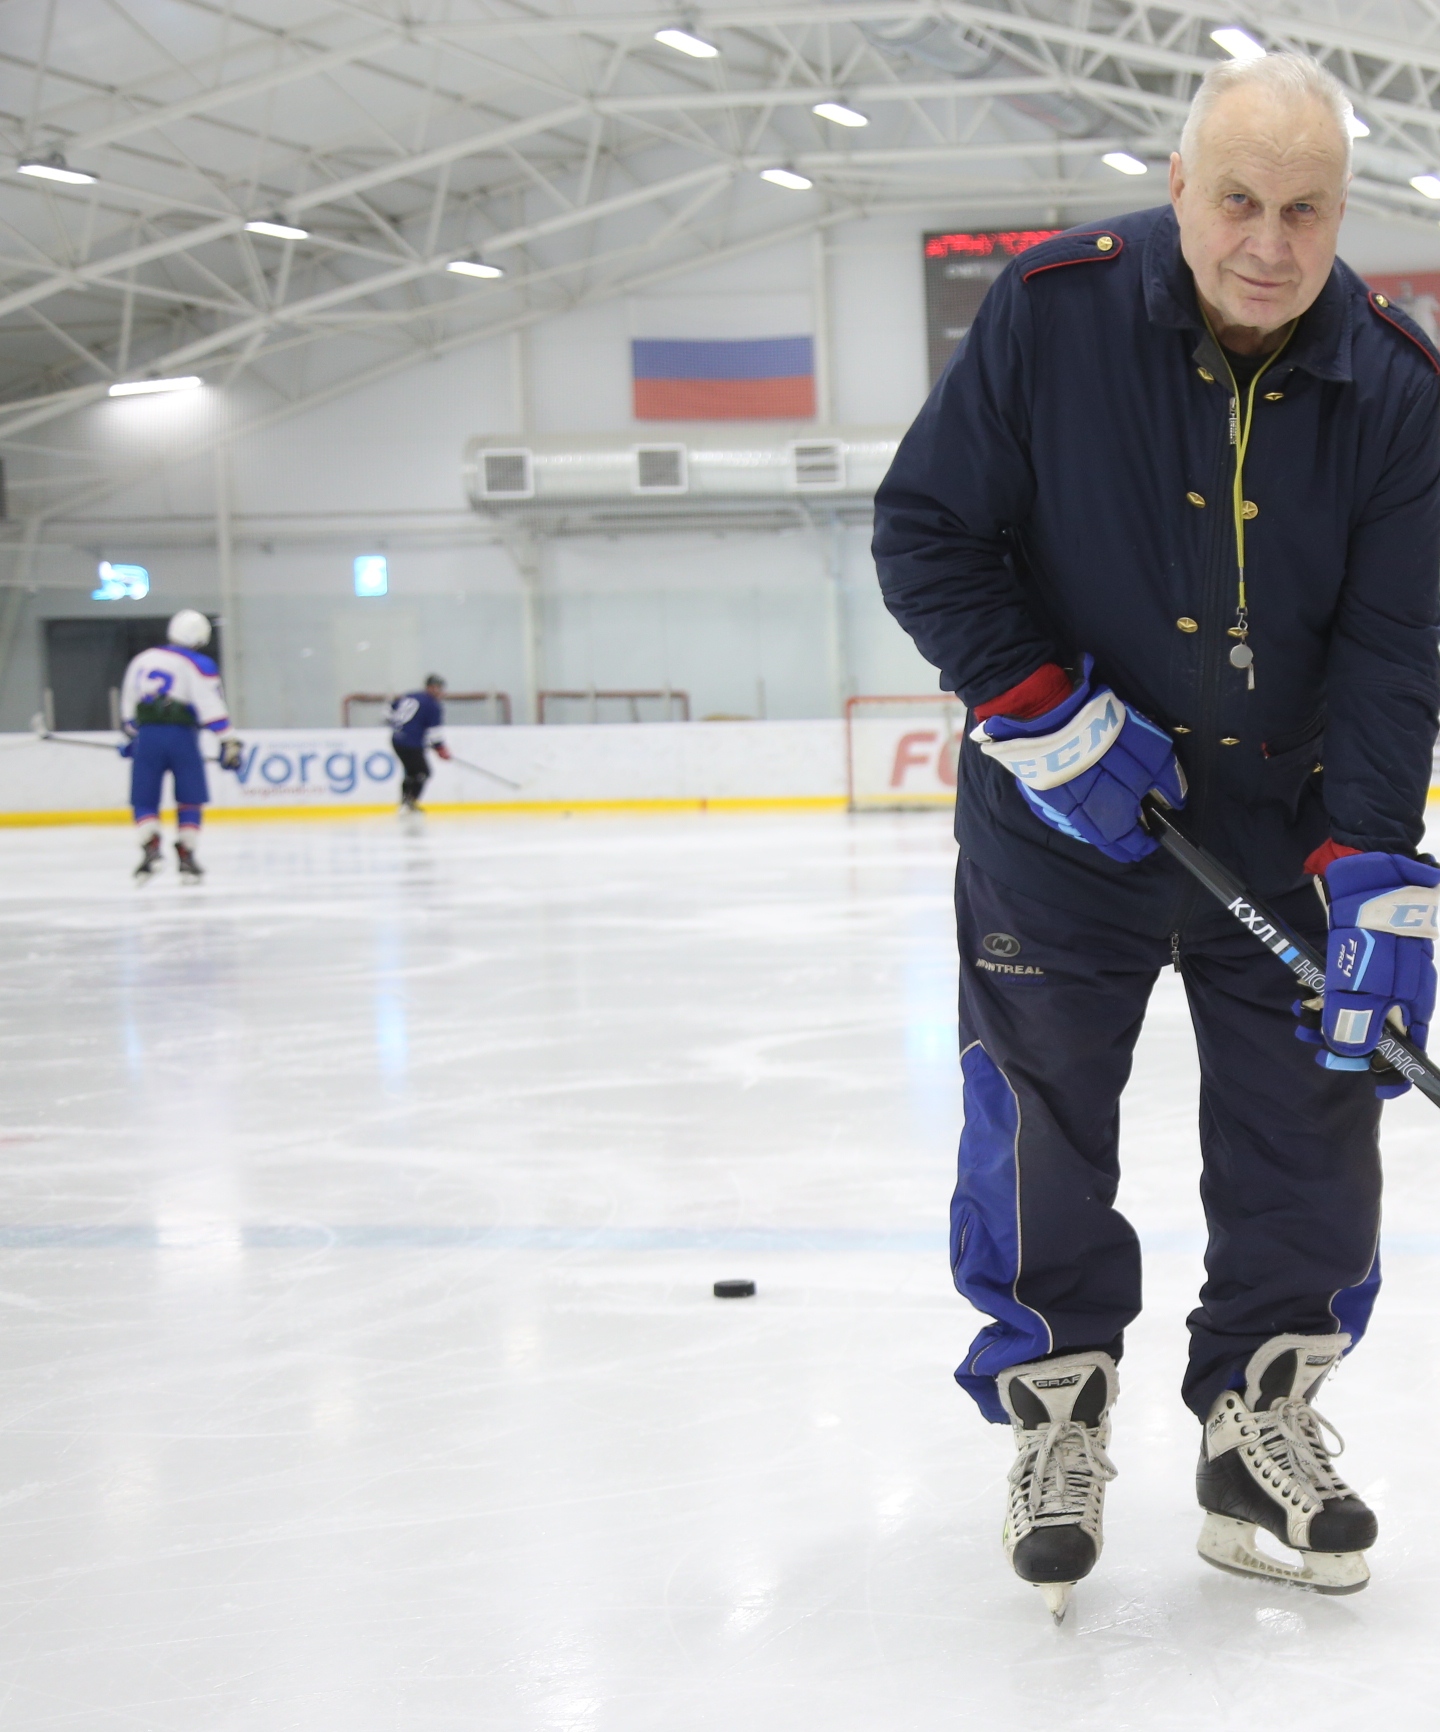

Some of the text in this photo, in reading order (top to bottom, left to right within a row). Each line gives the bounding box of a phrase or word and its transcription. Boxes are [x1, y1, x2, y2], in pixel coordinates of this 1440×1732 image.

[1009, 699, 1119, 779] CCM
[1227, 896, 1277, 942] КХЛ
[1035, 1375, 1081, 1388] GRAF
